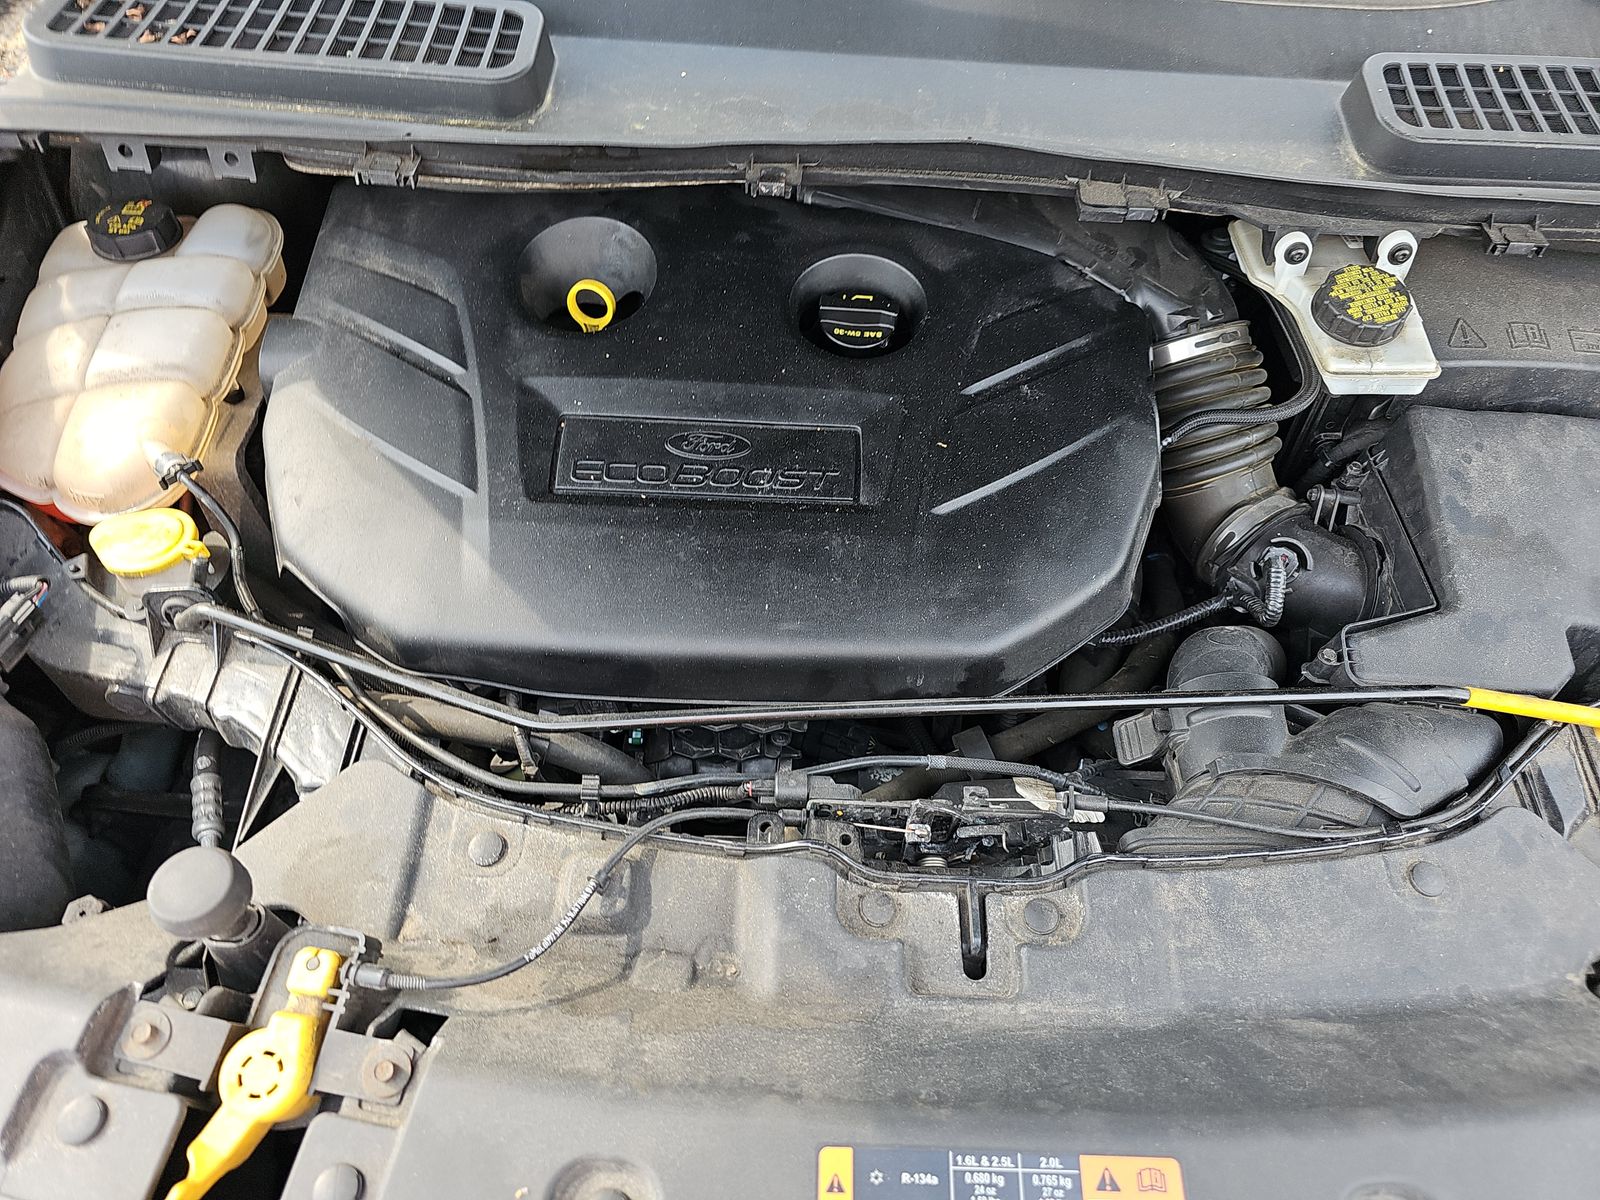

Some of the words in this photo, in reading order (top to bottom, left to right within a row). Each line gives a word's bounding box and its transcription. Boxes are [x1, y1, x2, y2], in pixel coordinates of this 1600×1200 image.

[681, 433, 736, 454] Ford
[570, 459, 841, 491] ECOBOOST
[956, 1154, 979, 1166] 1.6L
[981, 1155, 989, 1166] &
[991, 1155, 1015, 1168] 2.5L
[1040, 1157, 1064, 1169] 2.0L
[901, 1172, 939, 1185] R-134a
[964, 1171, 990, 1184] 0.680
[992, 1172, 1005, 1187] kg
[1032, 1173, 1058, 1186] 0.765
[1059, 1174, 1073, 1190] kg
[974, 1185, 985, 1195] 24
[986, 1187, 997, 1195] oz
[1054, 1189, 1065, 1197] oz
